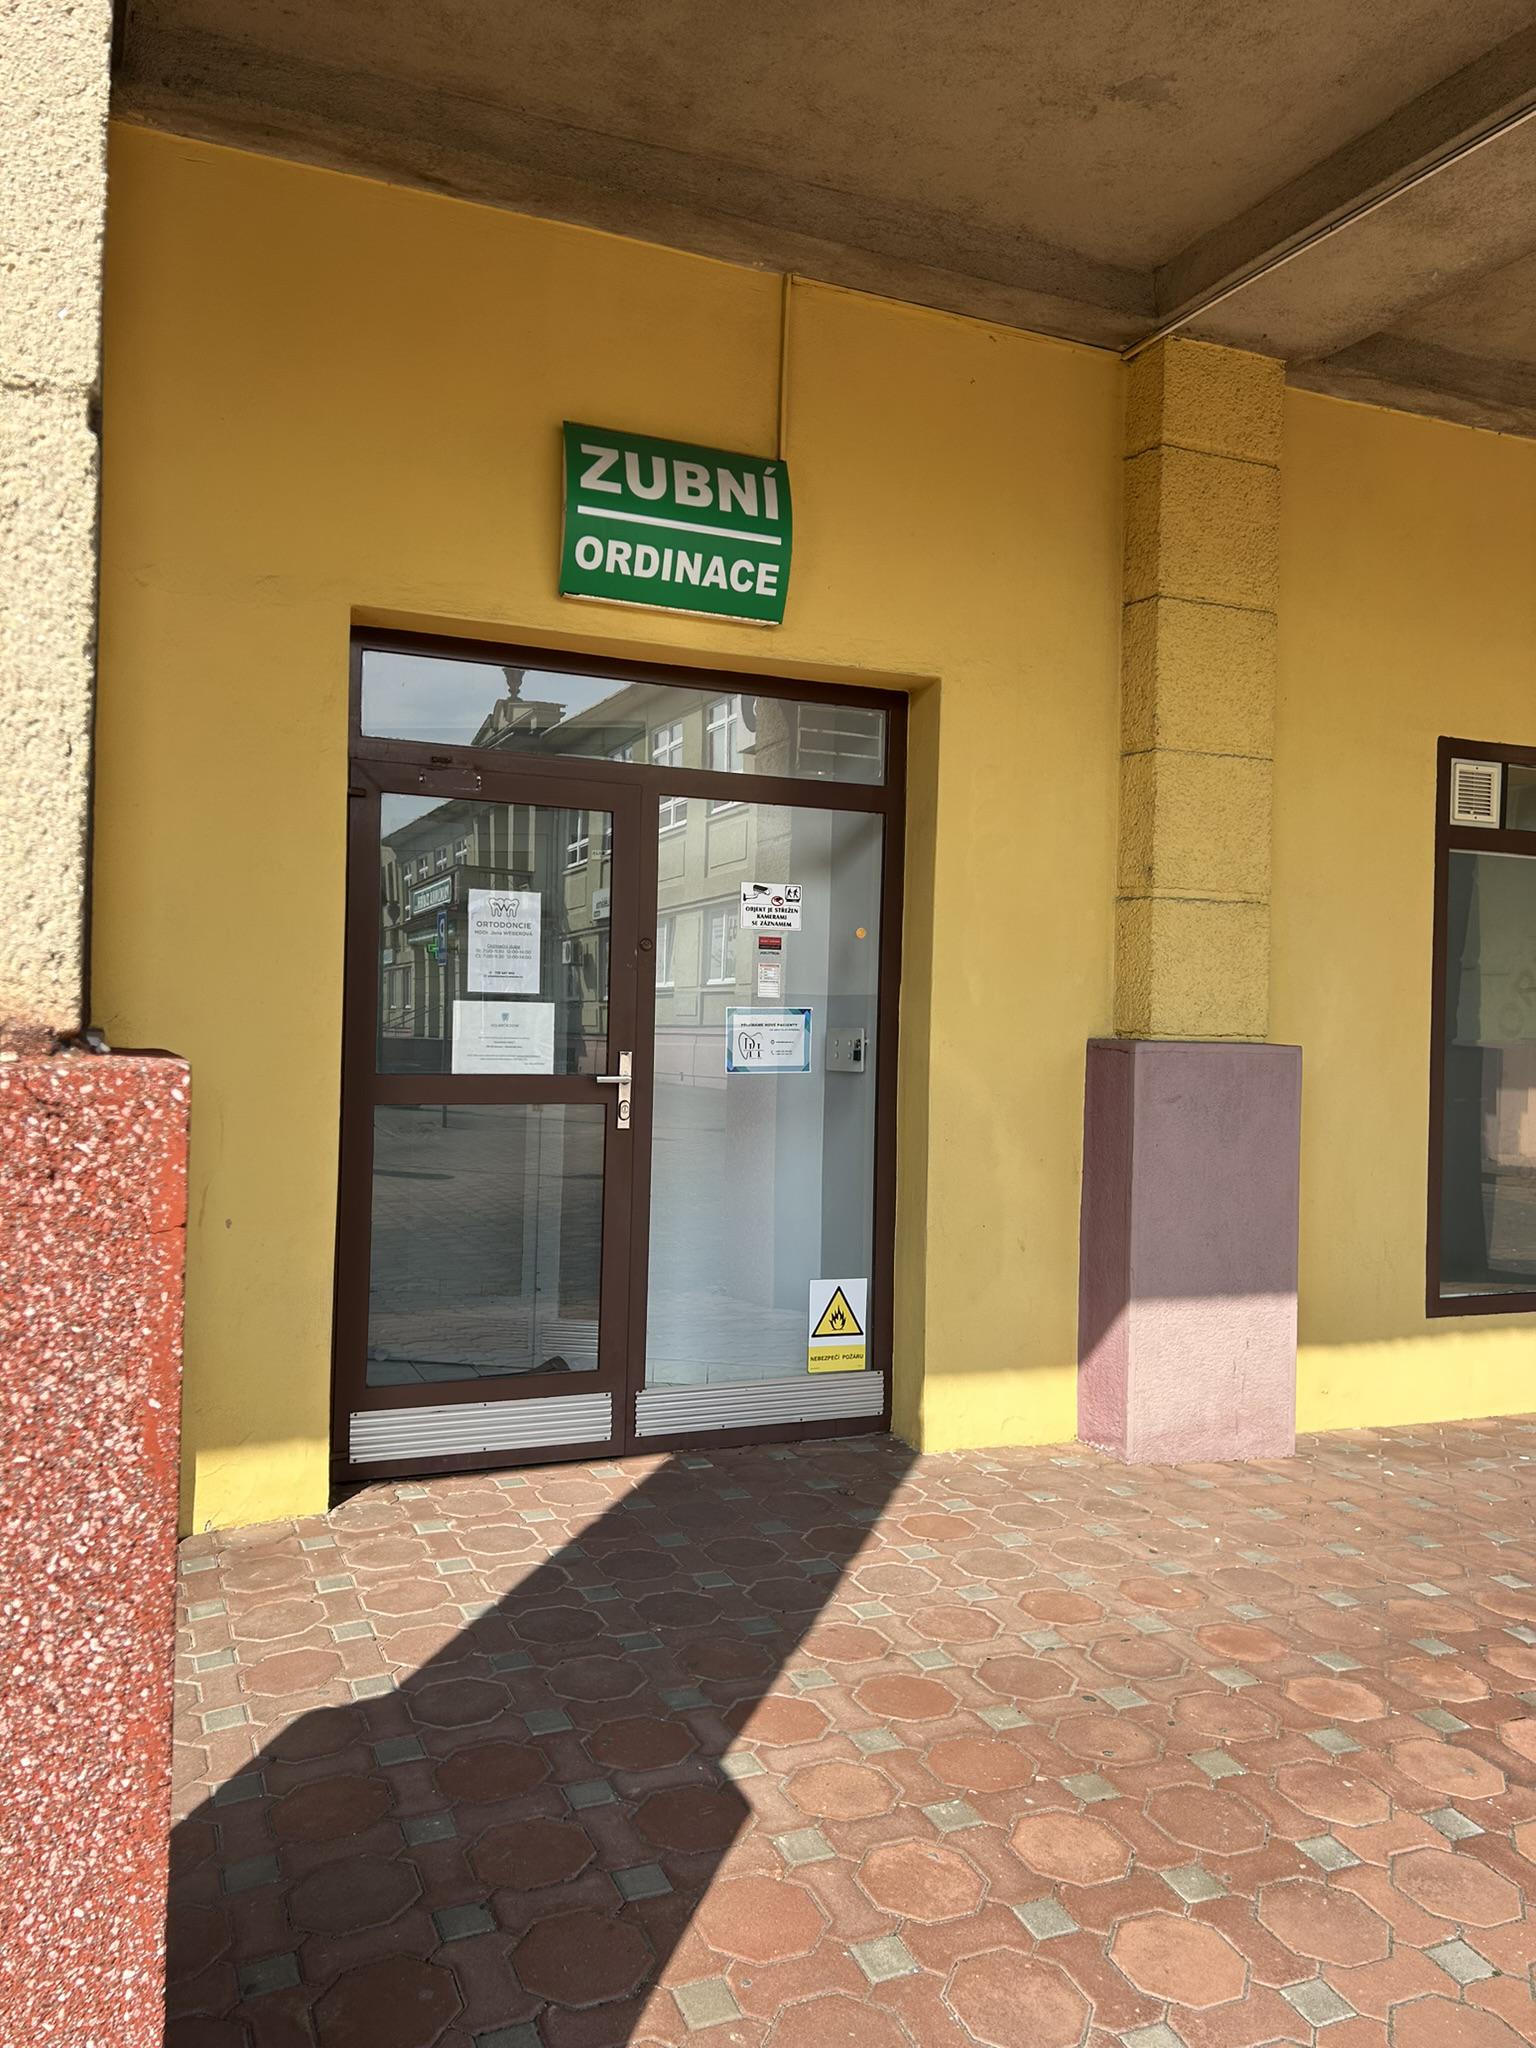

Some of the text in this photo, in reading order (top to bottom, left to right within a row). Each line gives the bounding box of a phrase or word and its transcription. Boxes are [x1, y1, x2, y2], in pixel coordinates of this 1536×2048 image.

[580, 443, 779, 521] ZUBNÍ
[574, 535, 780, 597] ORDINACE
[476, 921, 532, 929] ORTODONCIE
[745, 905, 799, 914] OBJEKT JE STŘEŽEN
